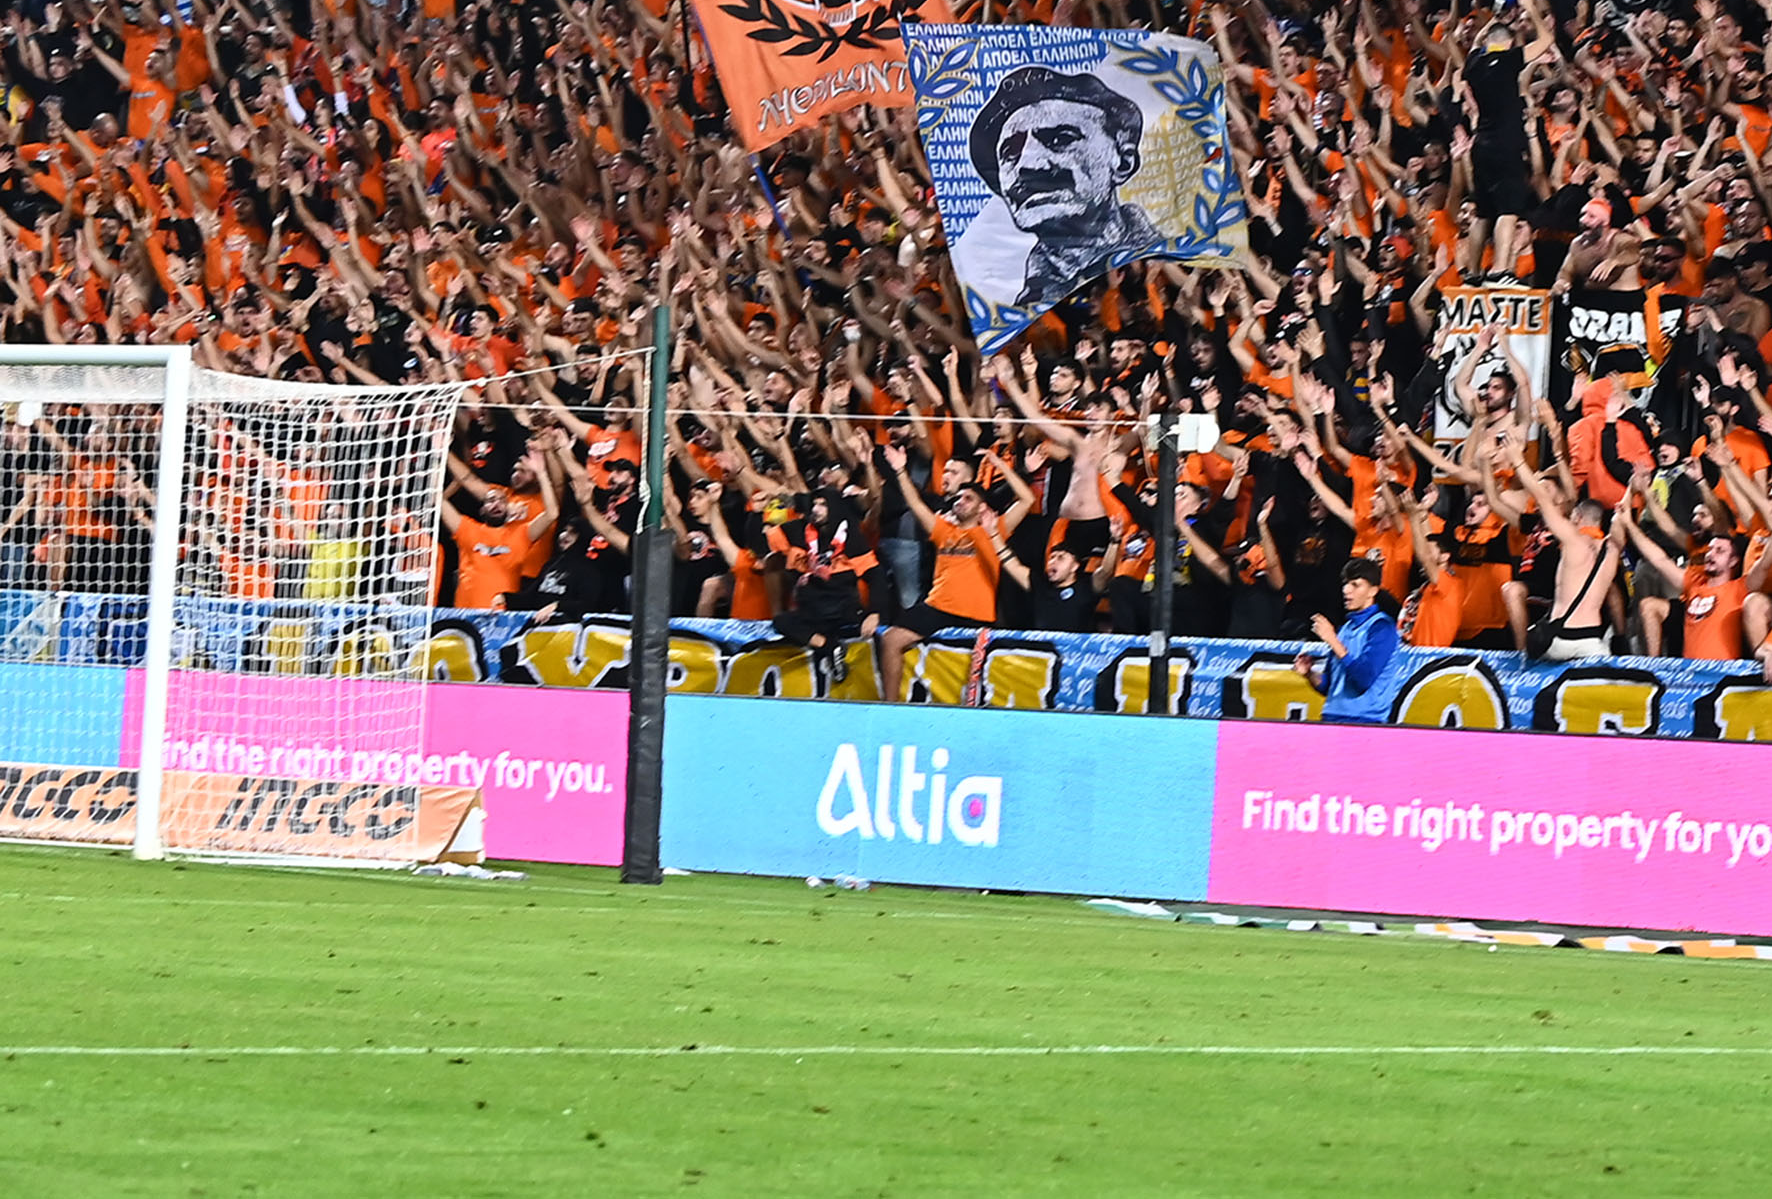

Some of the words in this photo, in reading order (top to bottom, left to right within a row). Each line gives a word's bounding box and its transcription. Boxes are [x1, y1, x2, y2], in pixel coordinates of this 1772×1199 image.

[980, 32, 1027, 50] ΑΠΟΕΛ
[982, 50, 1029, 69] ΑΠΟΕΛ
[1032, 41, 1098, 63] ΕΛΛΗΝΩΝ
[163, 738, 208, 770] ind
[214, 740, 266, 772] the
[493, 751, 544, 788] for
[545, 762, 614, 801] you.
[816, 743, 1003, 847] Altia
[1242, 790, 1321, 833] Find
[1325, 794, 1387, 837] the
[1393, 798, 1484, 852] right
[1490, 810, 1659, 864] property
[1663, 811, 1720, 855] for
